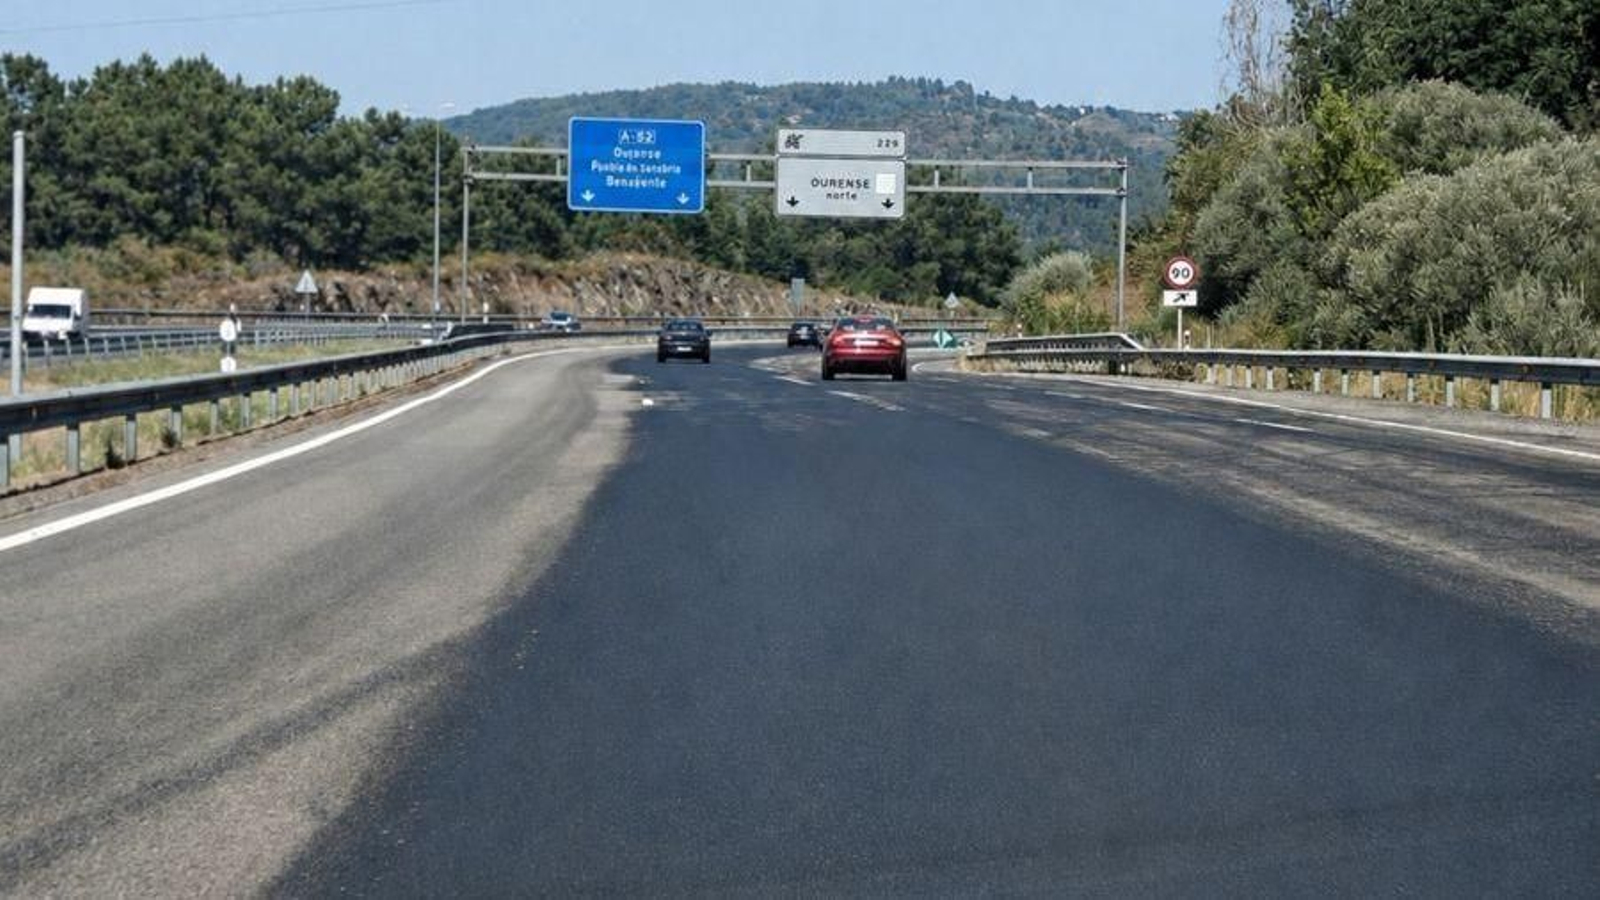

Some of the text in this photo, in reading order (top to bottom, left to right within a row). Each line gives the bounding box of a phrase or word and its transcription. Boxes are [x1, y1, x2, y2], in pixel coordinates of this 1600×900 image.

[613, 147, 661, 159] Ourense
[606, 175, 667, 188] Benavente
[811, 178, 870, 189] OURENSE
[826, 191, 857, 200] norte
[1172, 267, 1190, 279] 90
